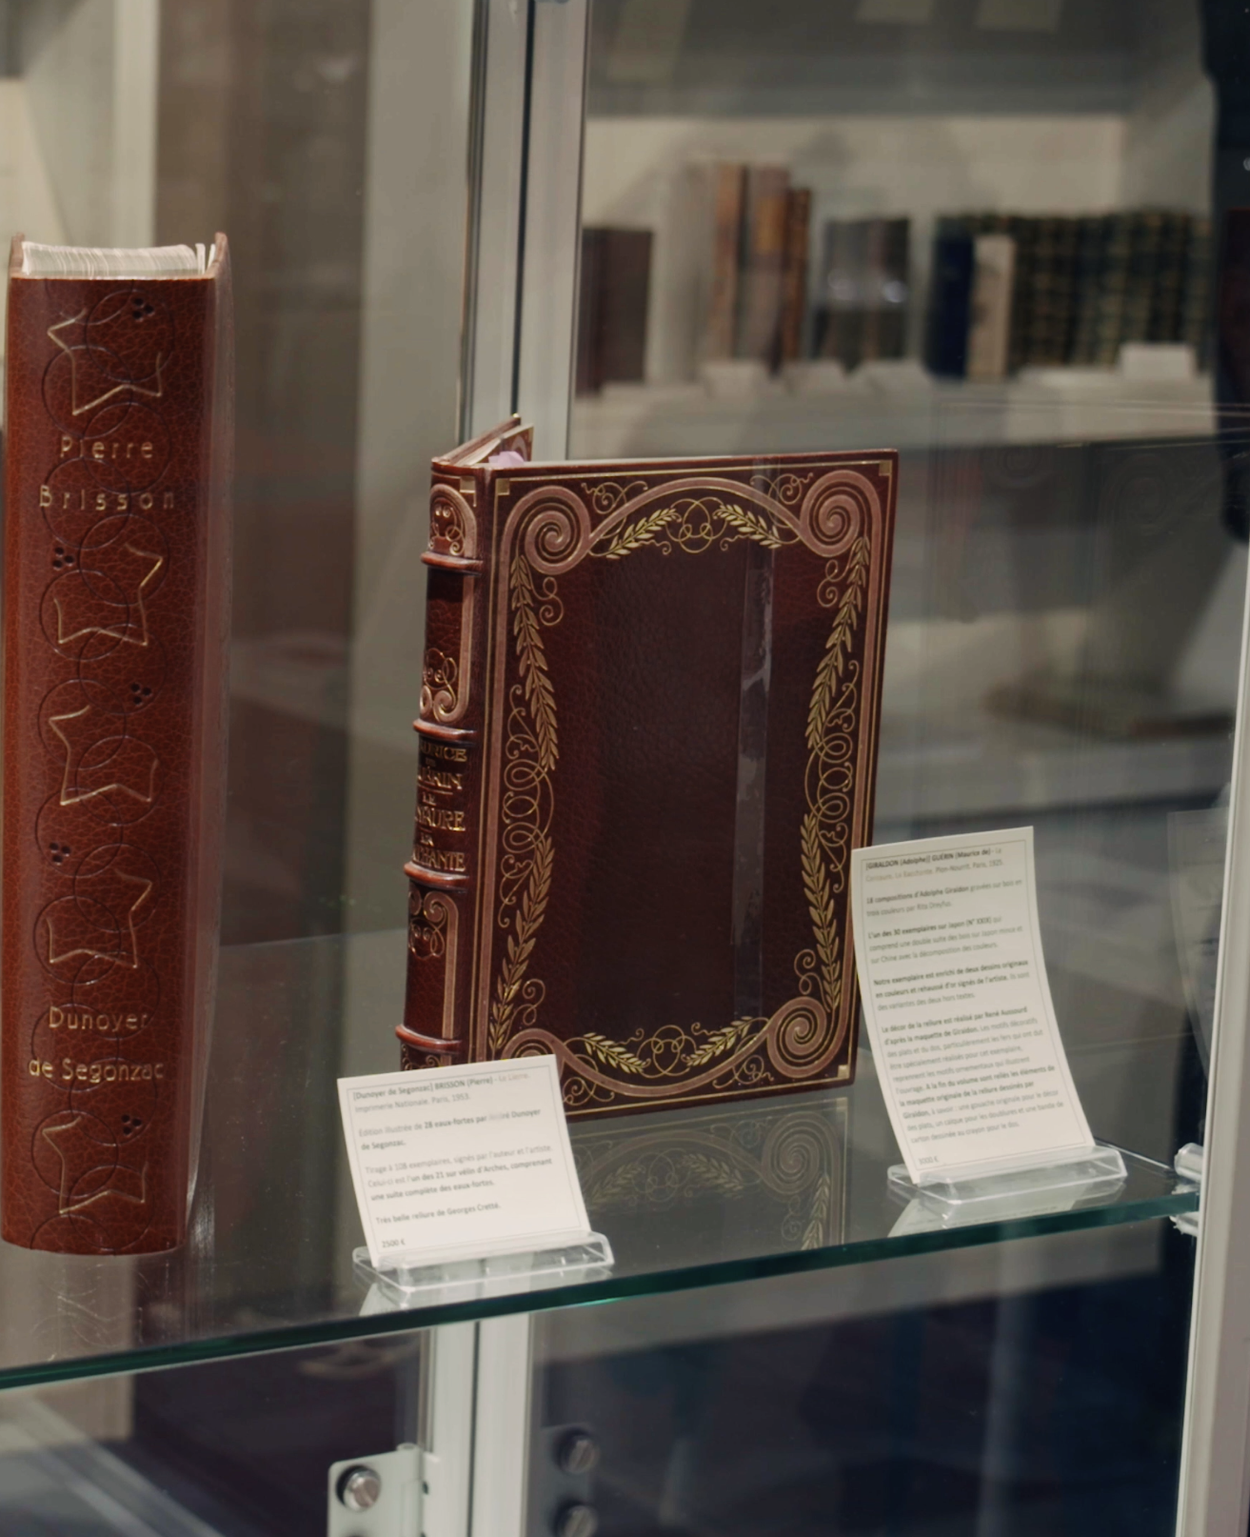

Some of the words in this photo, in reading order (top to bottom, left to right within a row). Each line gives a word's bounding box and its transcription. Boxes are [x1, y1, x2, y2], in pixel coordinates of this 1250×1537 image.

[60, 436, 153, 459] Pierre
[39, 484, 174, 511] Brisson
[48, 1006, 148, 1032] Dunoyer
[28, 1057, 54, 1079] de
[61, 1057, 164, 1084] Segonzac
